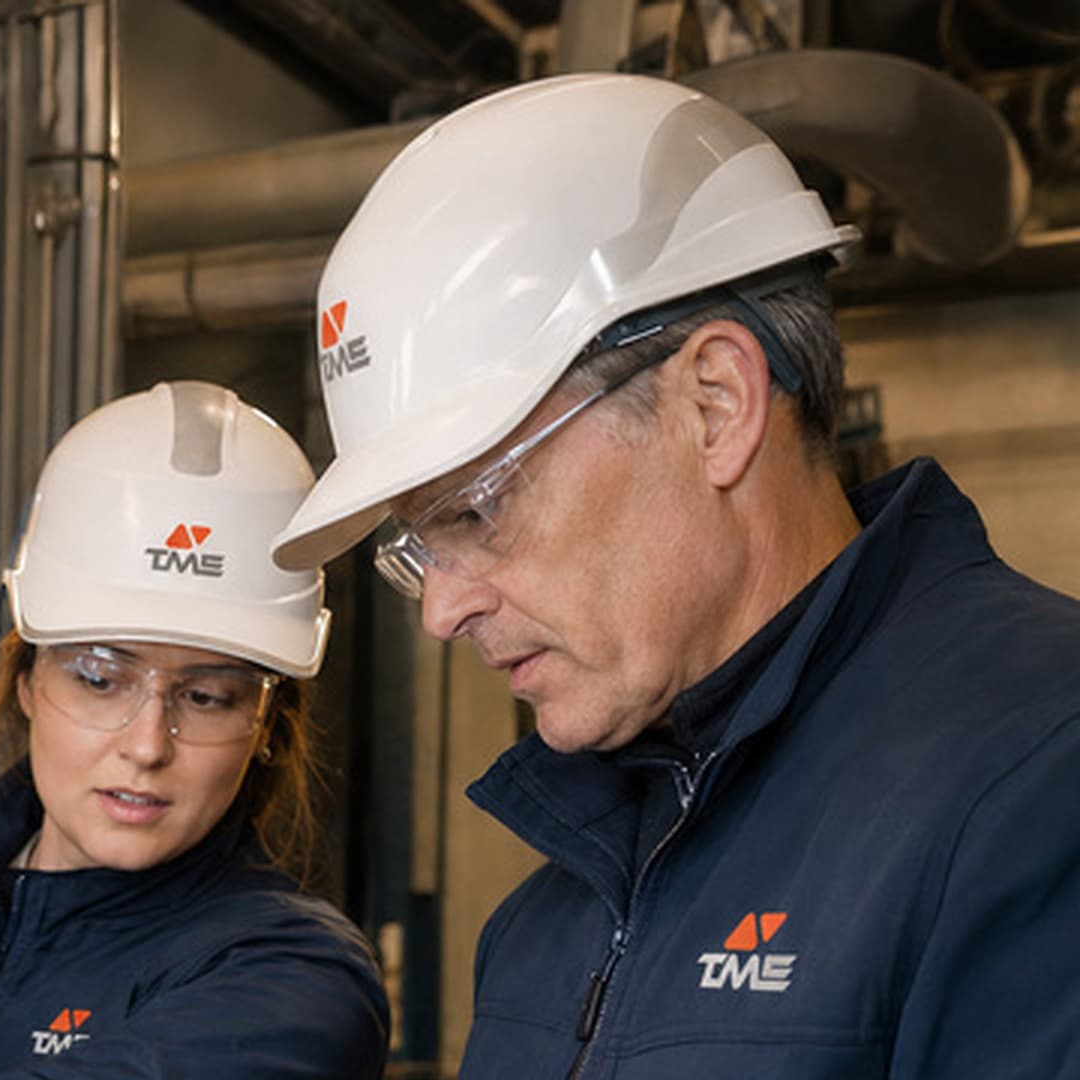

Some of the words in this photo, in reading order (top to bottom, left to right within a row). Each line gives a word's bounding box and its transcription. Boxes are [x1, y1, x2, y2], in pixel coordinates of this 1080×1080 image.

[145, 548, 225, 577] TME
[697, 953, 797, 992] TME
[31, 1031, 90, 1055] TM
